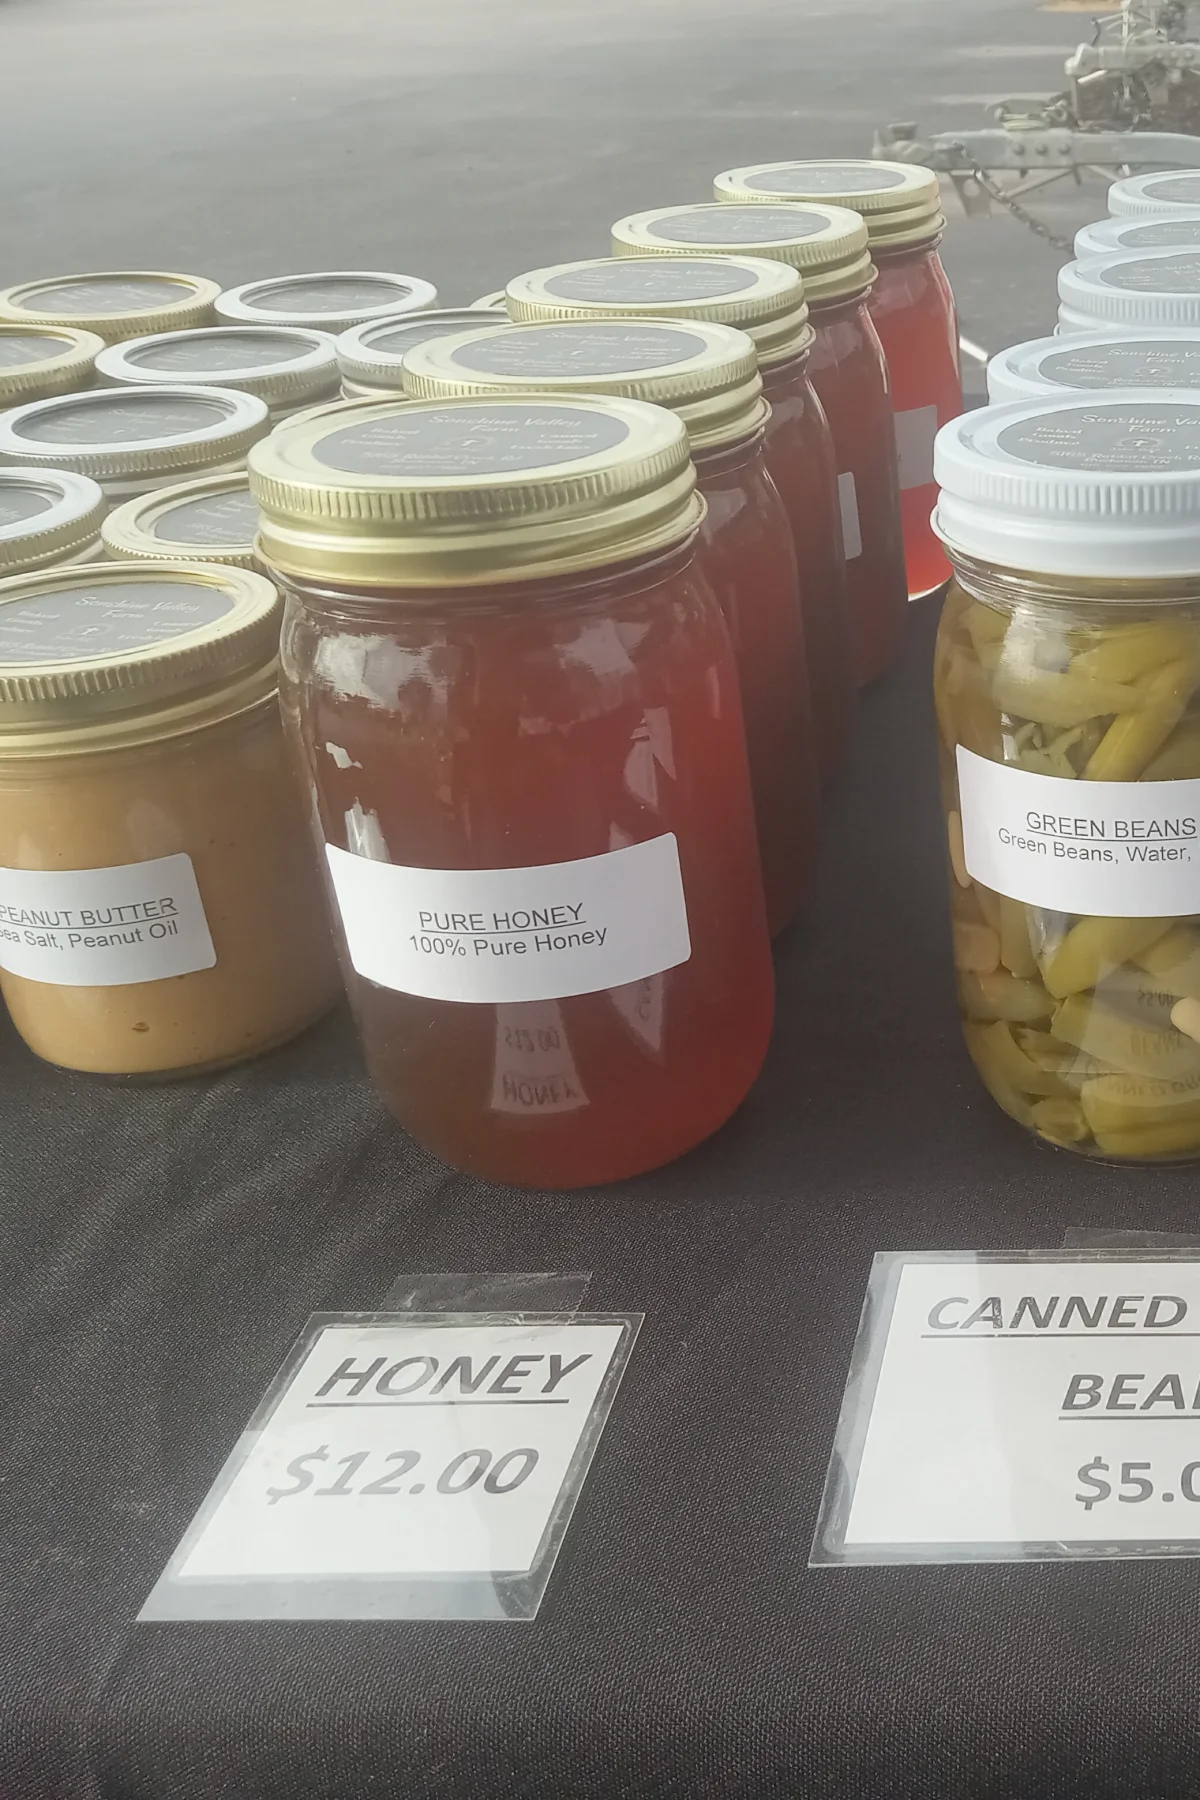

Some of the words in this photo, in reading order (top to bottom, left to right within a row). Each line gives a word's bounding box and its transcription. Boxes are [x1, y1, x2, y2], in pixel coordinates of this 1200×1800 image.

[1081, 414, 1167, 425] Sonshine
[1128, 425, 1177, 433] Farm
[1026, 811, 1105, 838] GREEN
[1114, 818, 1197, 838] BEANS
[998, 828, 1047, 855] Green
[1053, 843, 1119, 864] Beans,
[1126, 845, 1192, 863] Water,
[0, 904, 73, 926] PEANUT
[80, 897, 178, 926] BUTTER
[418, 911, 486, 931] PURE
[494, 903, 584, 930] HONEY
[24, 930, 63, 950] Salt,
[68, 929, 144, 949] Peanut
[149, 921, 178, 939] Oil
[409, 934, 467, 956] 100%
[473, 938, 527, 956] Pure
[534, 927, 608, 953] Honey
[927, 1295, 1188, 1330] CANNED
[315, 1354, 593, 1397] HONEY
[266, 1445, 540, 1505] $12.00
